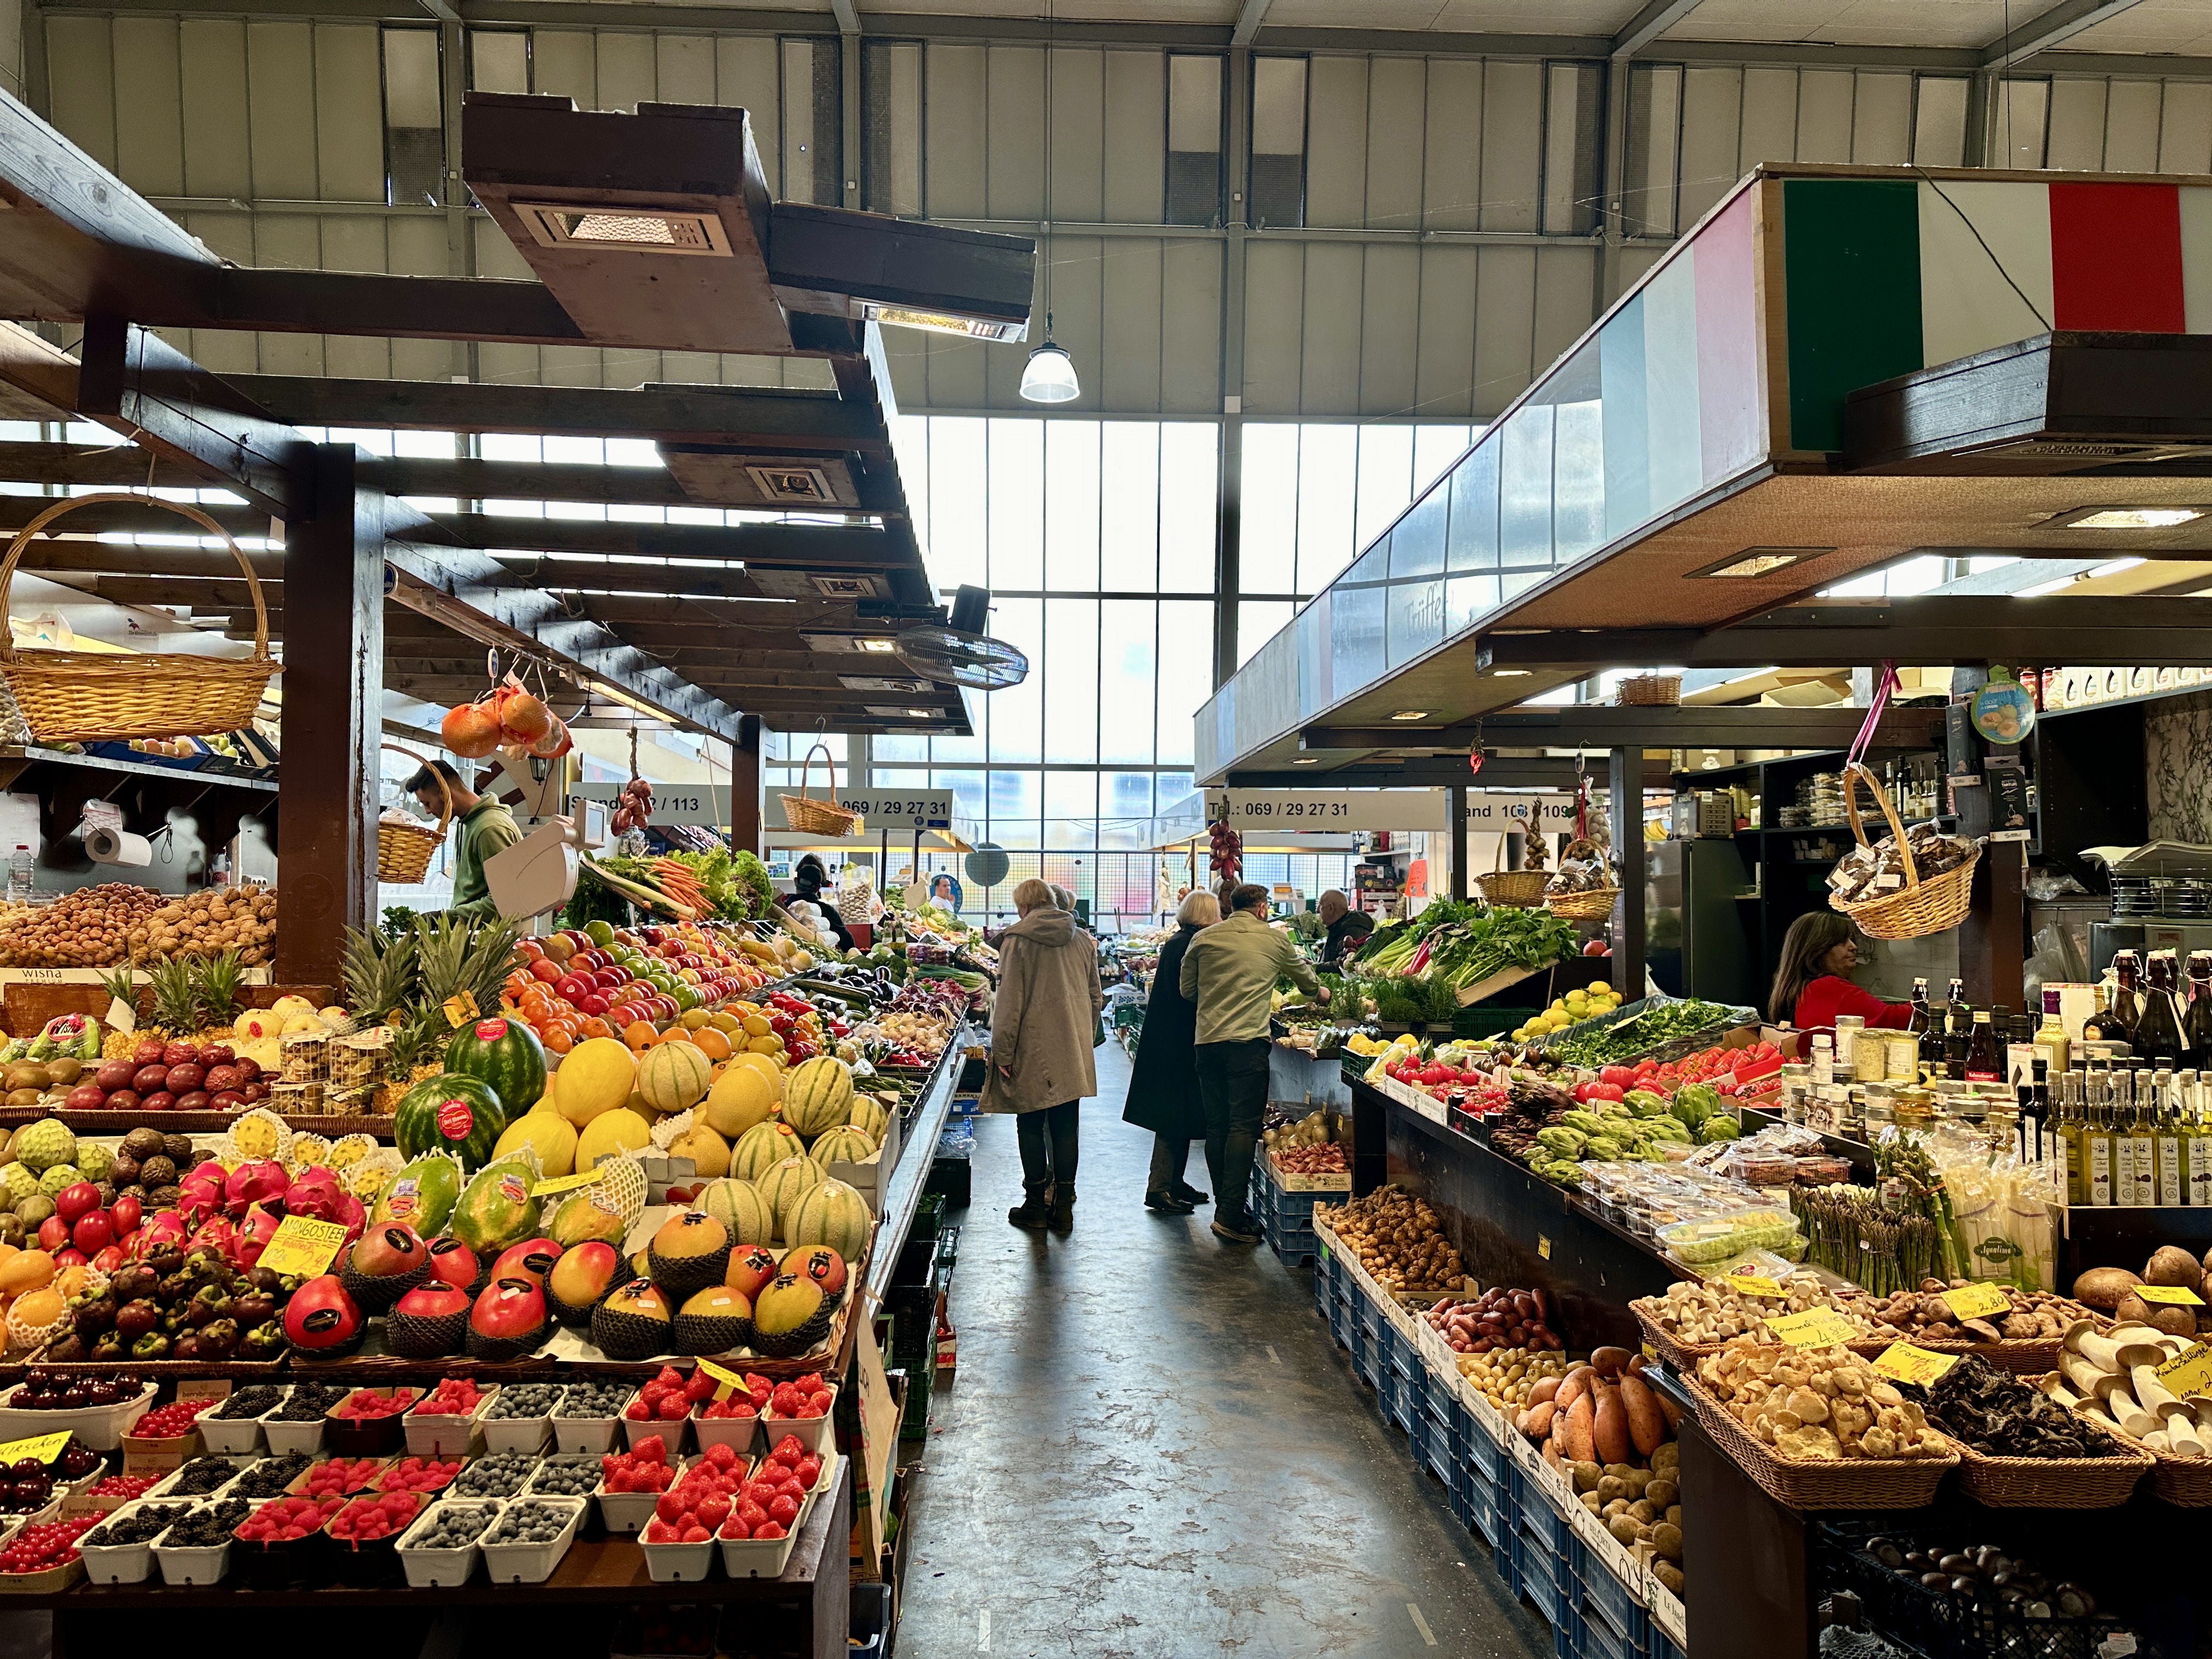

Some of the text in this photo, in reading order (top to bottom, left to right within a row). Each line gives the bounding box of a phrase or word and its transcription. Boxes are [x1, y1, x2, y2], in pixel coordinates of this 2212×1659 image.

[571, 796, 618, 810] Snd
[672, 798, 699, 811] 113
[842, 800, 946, 815] 069 / 29 27 31
[1209, 803, 1348, 816] Tl.: 069 / 29 27 31
[1466, 805, 1491, 817] and
[1543, 805, 1570, 817] 109
[1773, 1320, 1813, 1334] Semmel
